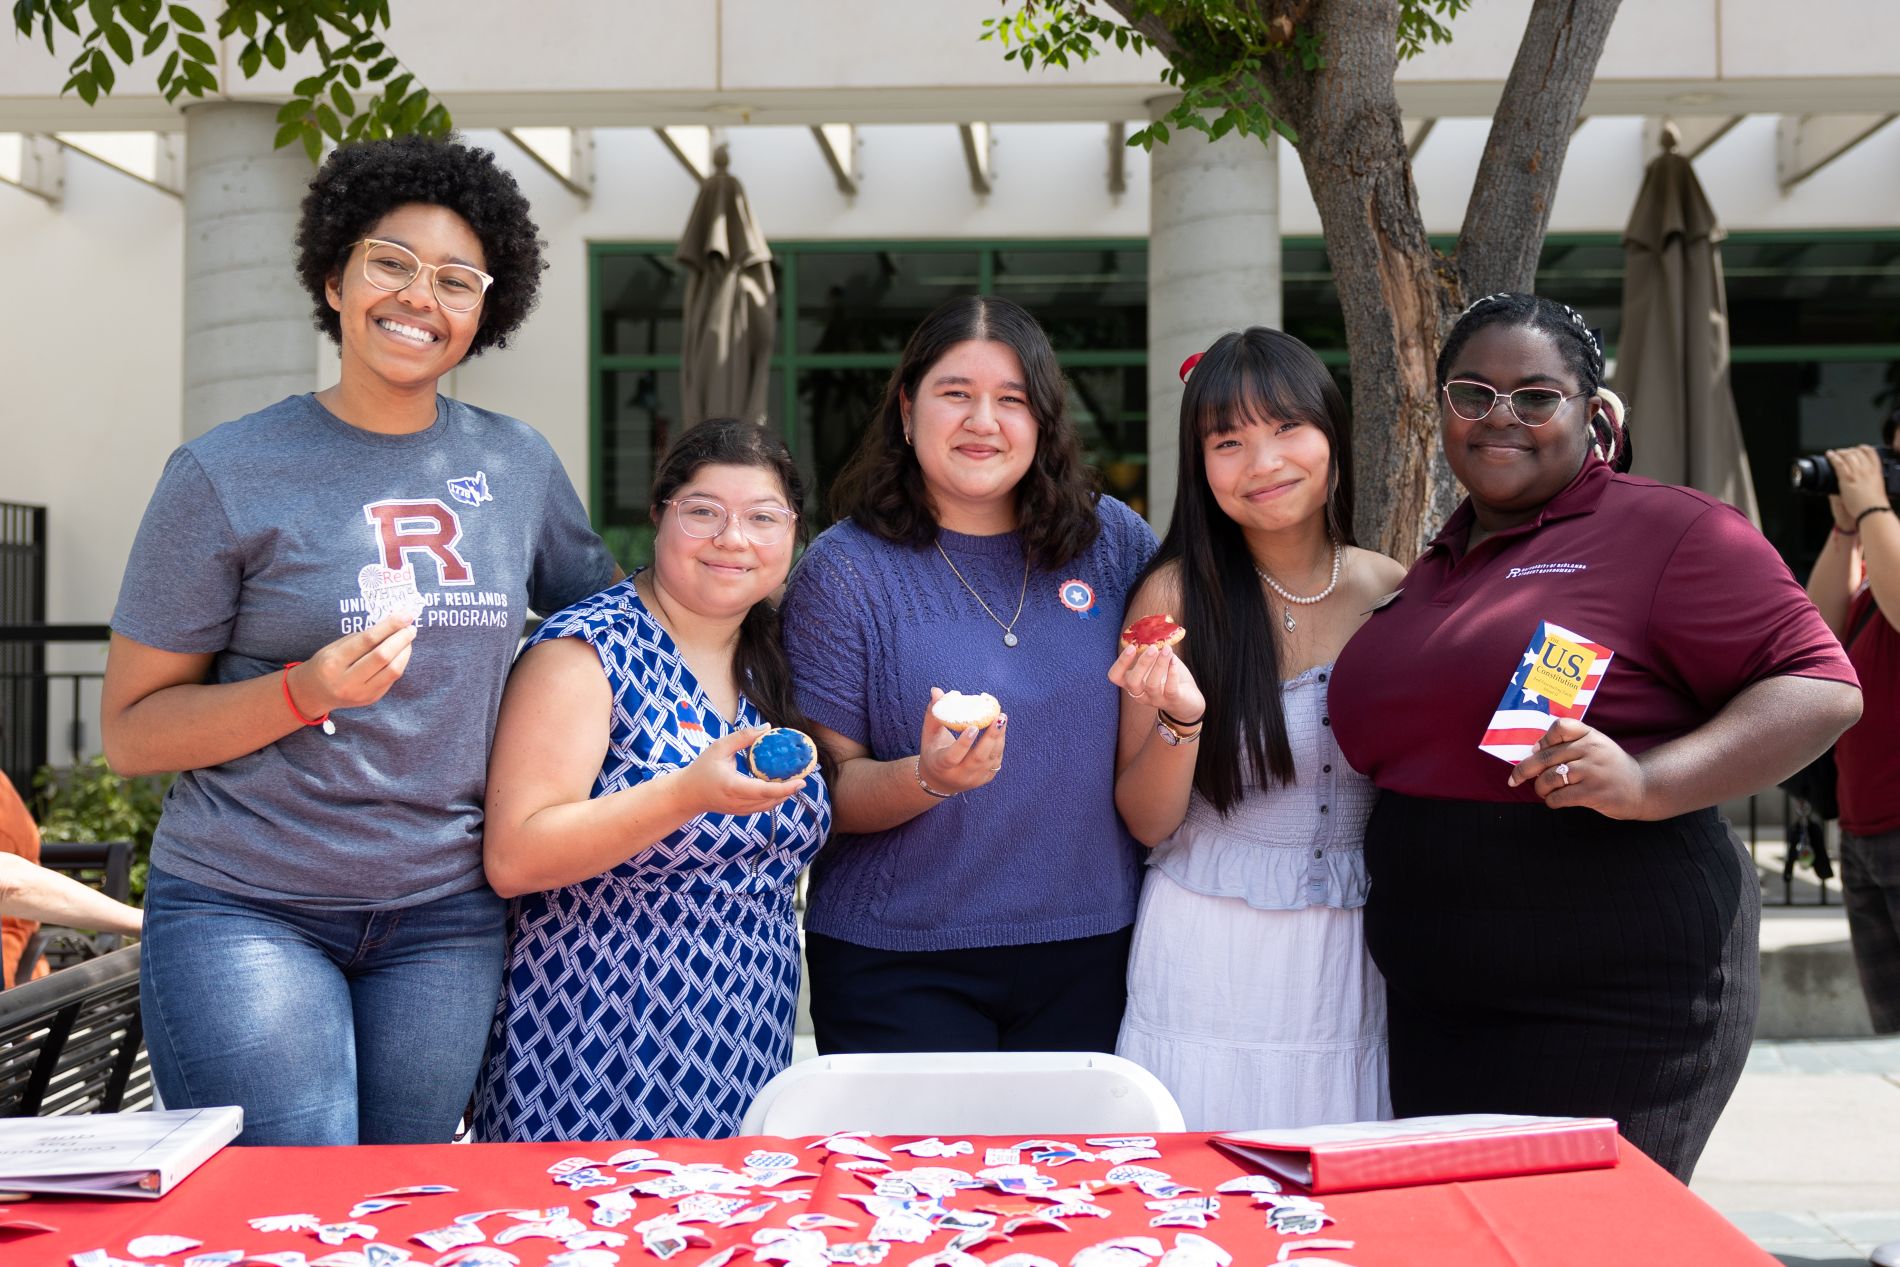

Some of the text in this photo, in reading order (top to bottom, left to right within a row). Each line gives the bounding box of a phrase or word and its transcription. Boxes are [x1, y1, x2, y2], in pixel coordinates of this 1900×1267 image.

[363, 498, 475, 586] R
[383, 569, 412, 585] Red
[425, 593, 439, 607] OF
[444, 592, 508, 607] REDLANDS
[428, 609, 508, 628] PROGRAMS
[1542, 641, 1582, 682] U.S.
[1536, 665, 1579, 690] Constitution
